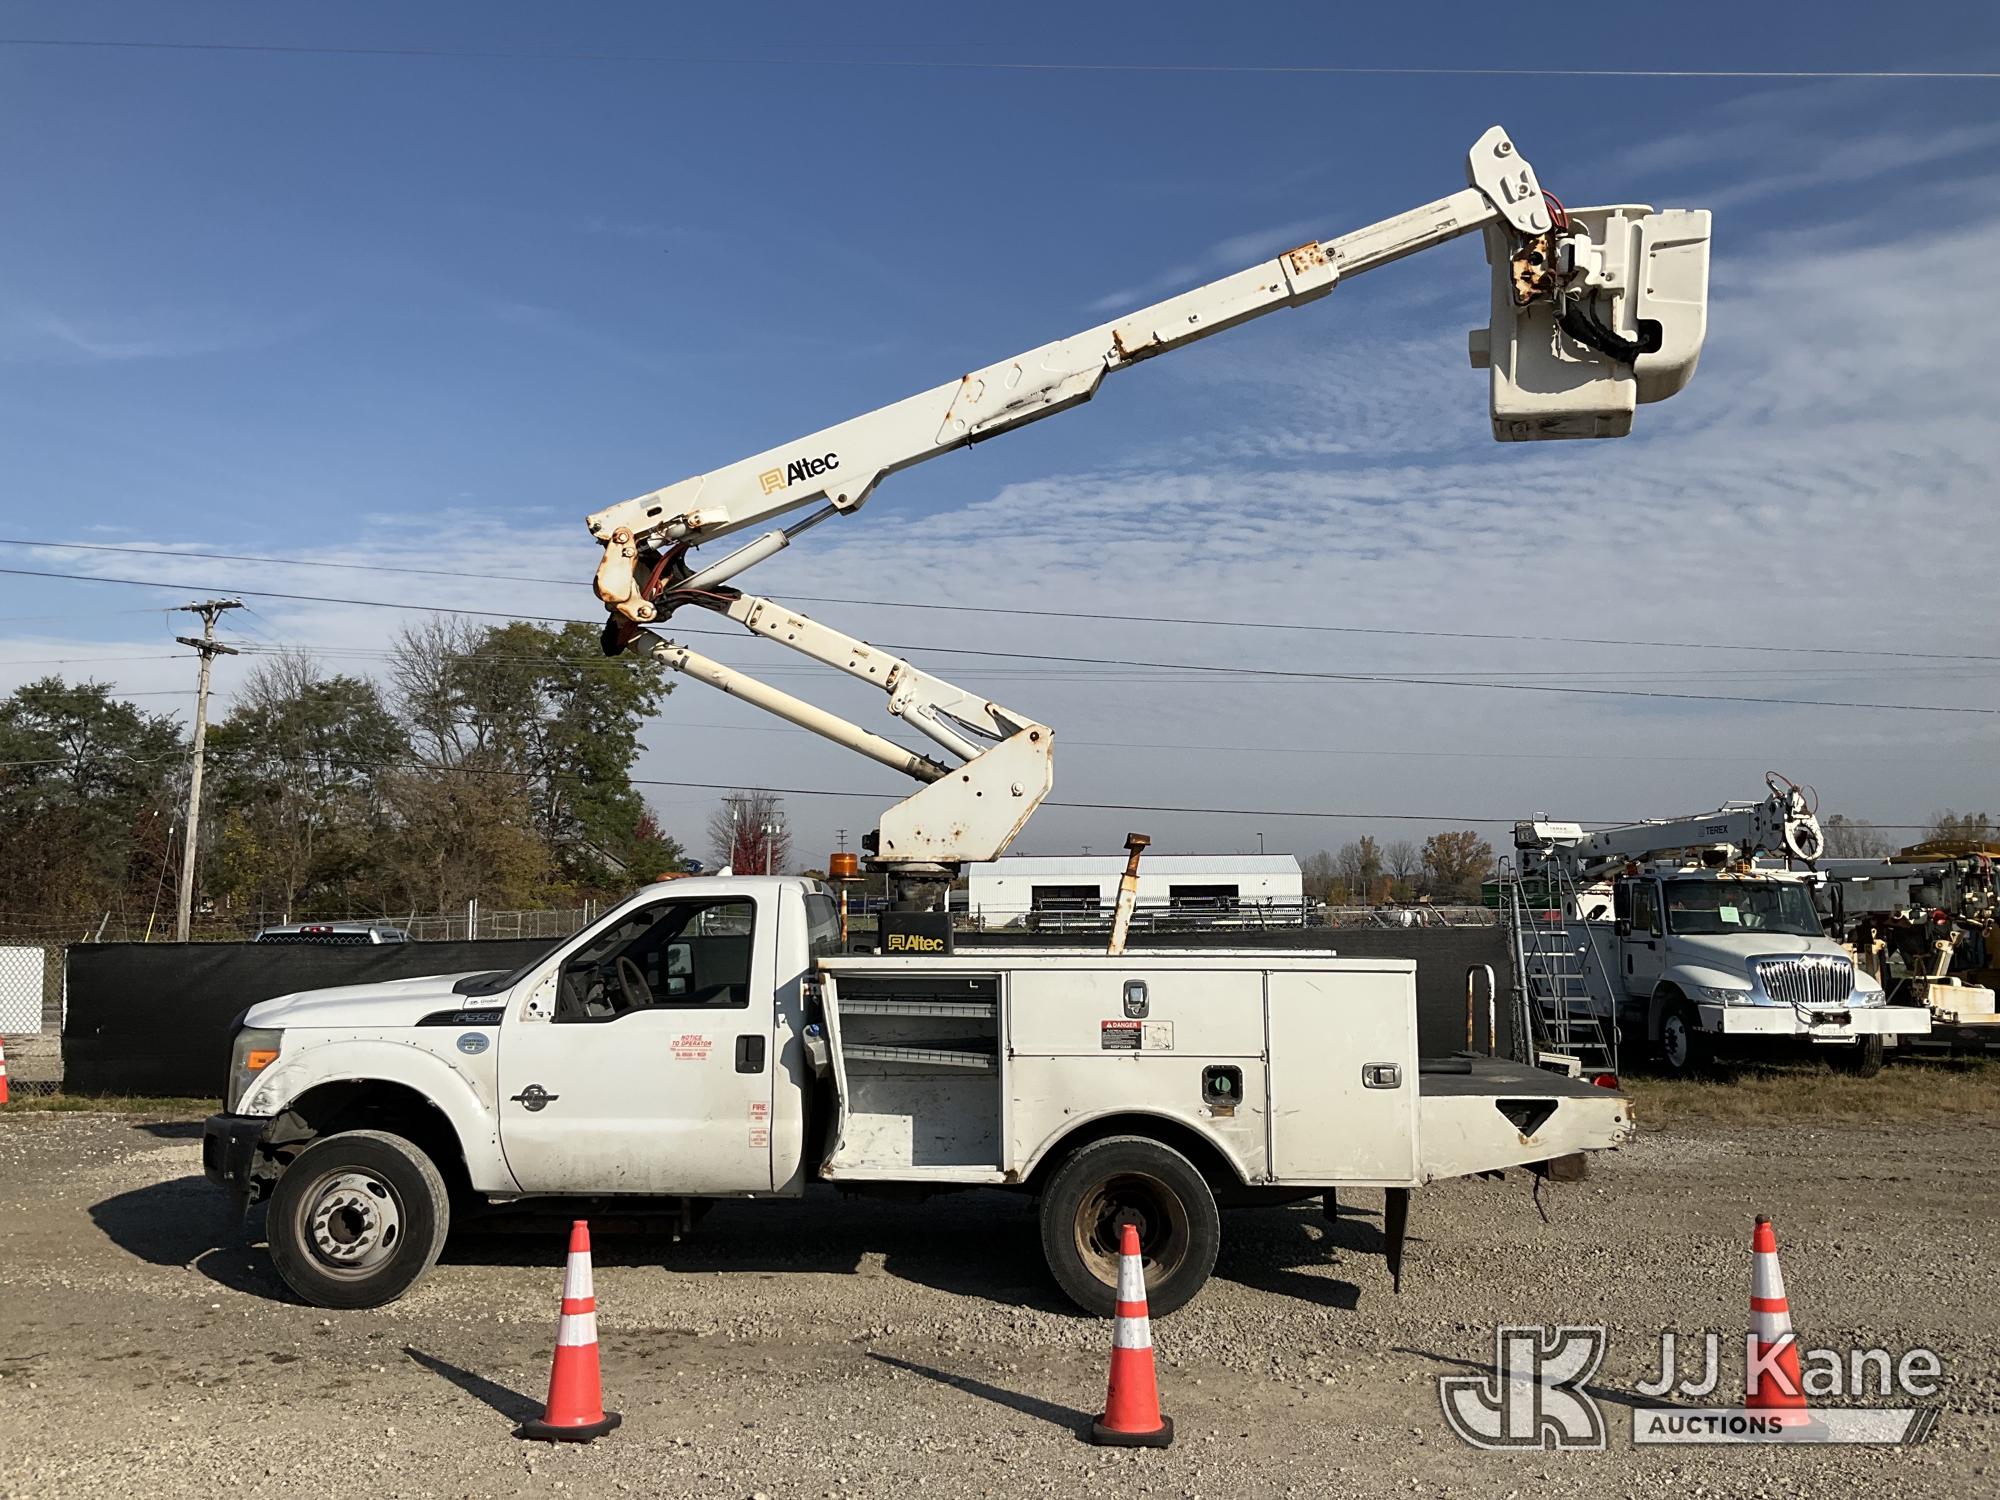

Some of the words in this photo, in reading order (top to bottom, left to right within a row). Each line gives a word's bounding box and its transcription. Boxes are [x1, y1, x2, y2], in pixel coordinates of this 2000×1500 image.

[787, 452, 840, 487] Altec
[1705, 825, 1729, 835] TEREX
[905, 934, 945, 951] Altec
[752, 1103, 767, 1111] FIRE
